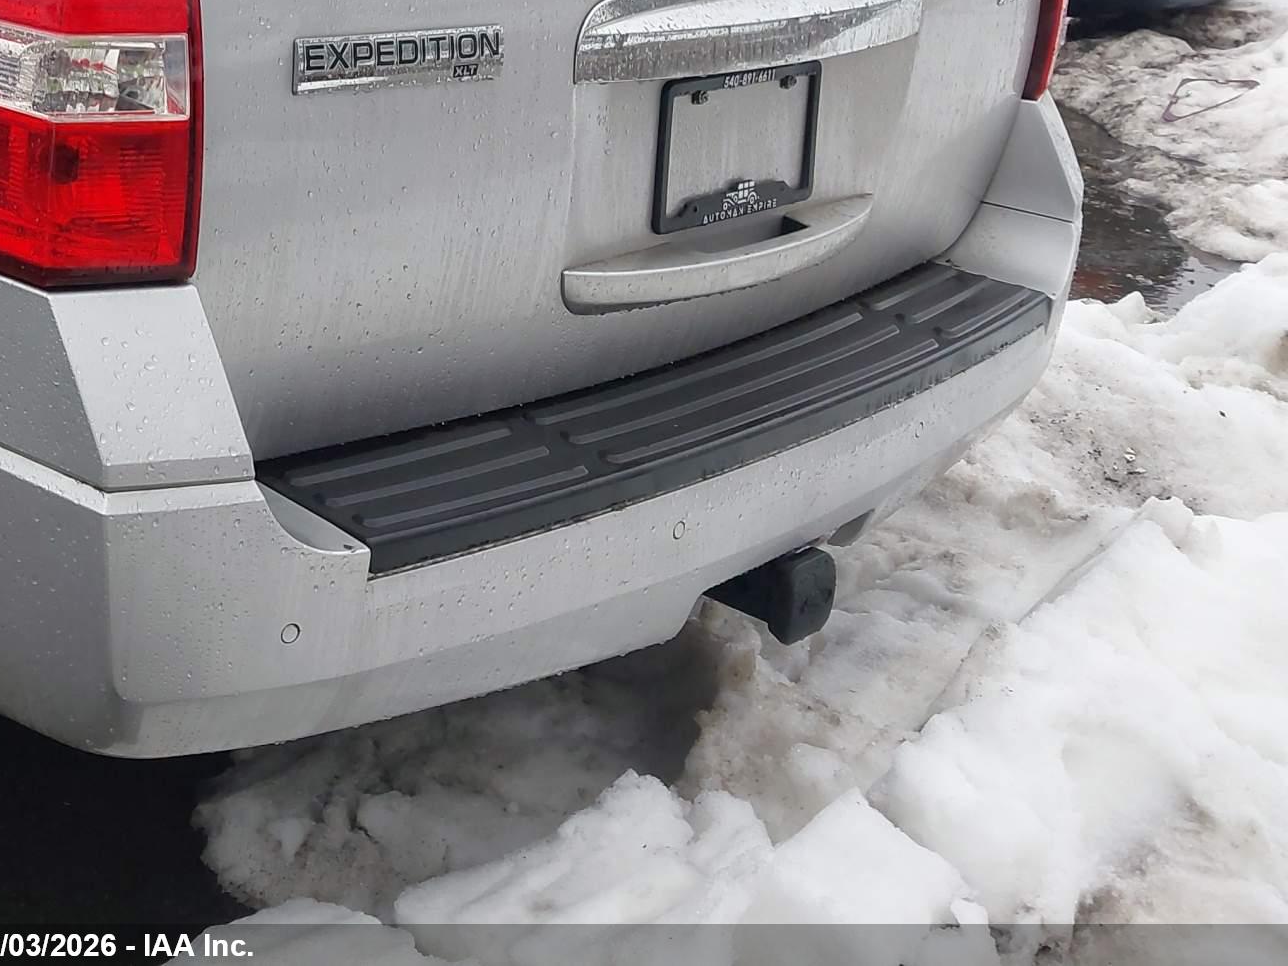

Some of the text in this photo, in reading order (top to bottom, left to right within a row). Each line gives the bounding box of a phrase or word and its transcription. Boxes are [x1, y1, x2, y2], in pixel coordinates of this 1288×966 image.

[305, 31, 500, 71] EXPEDITION
[454, 64, 478, 77] XLT
[747, 198, 777, 214] EMPIRE
